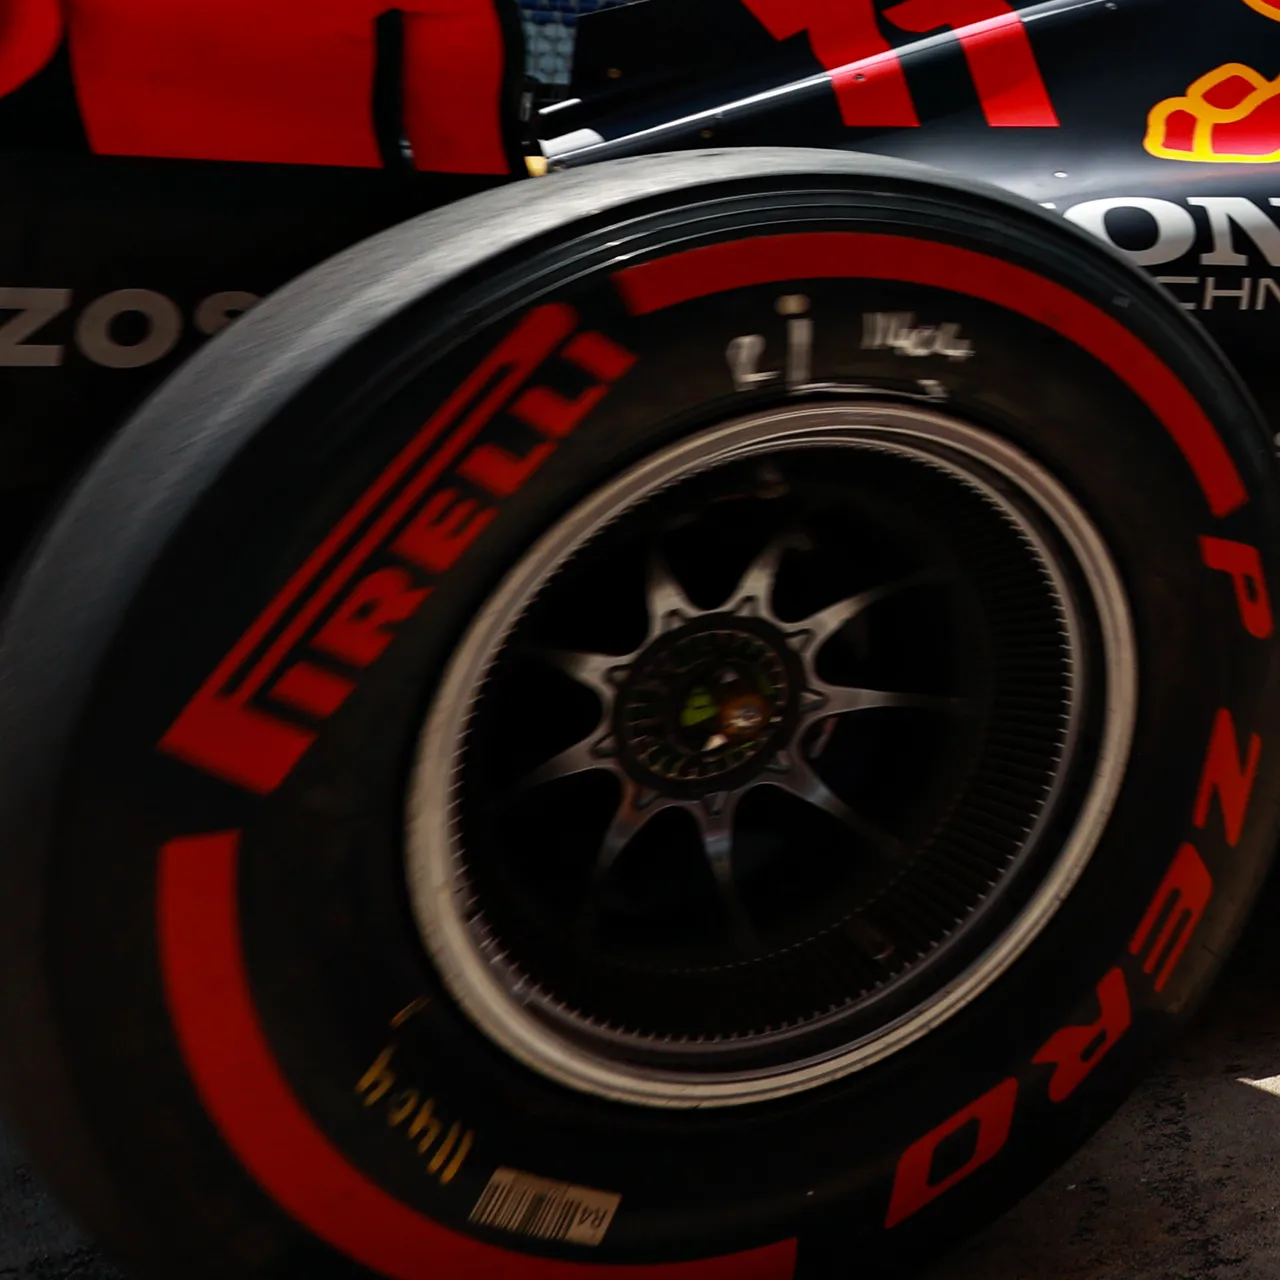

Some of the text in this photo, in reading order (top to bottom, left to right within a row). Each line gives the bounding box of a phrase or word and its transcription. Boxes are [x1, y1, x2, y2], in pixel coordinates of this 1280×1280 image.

[157, 302, 640, 796] PIRELLI
[886, 534, 1275, 1229] P ZERO
